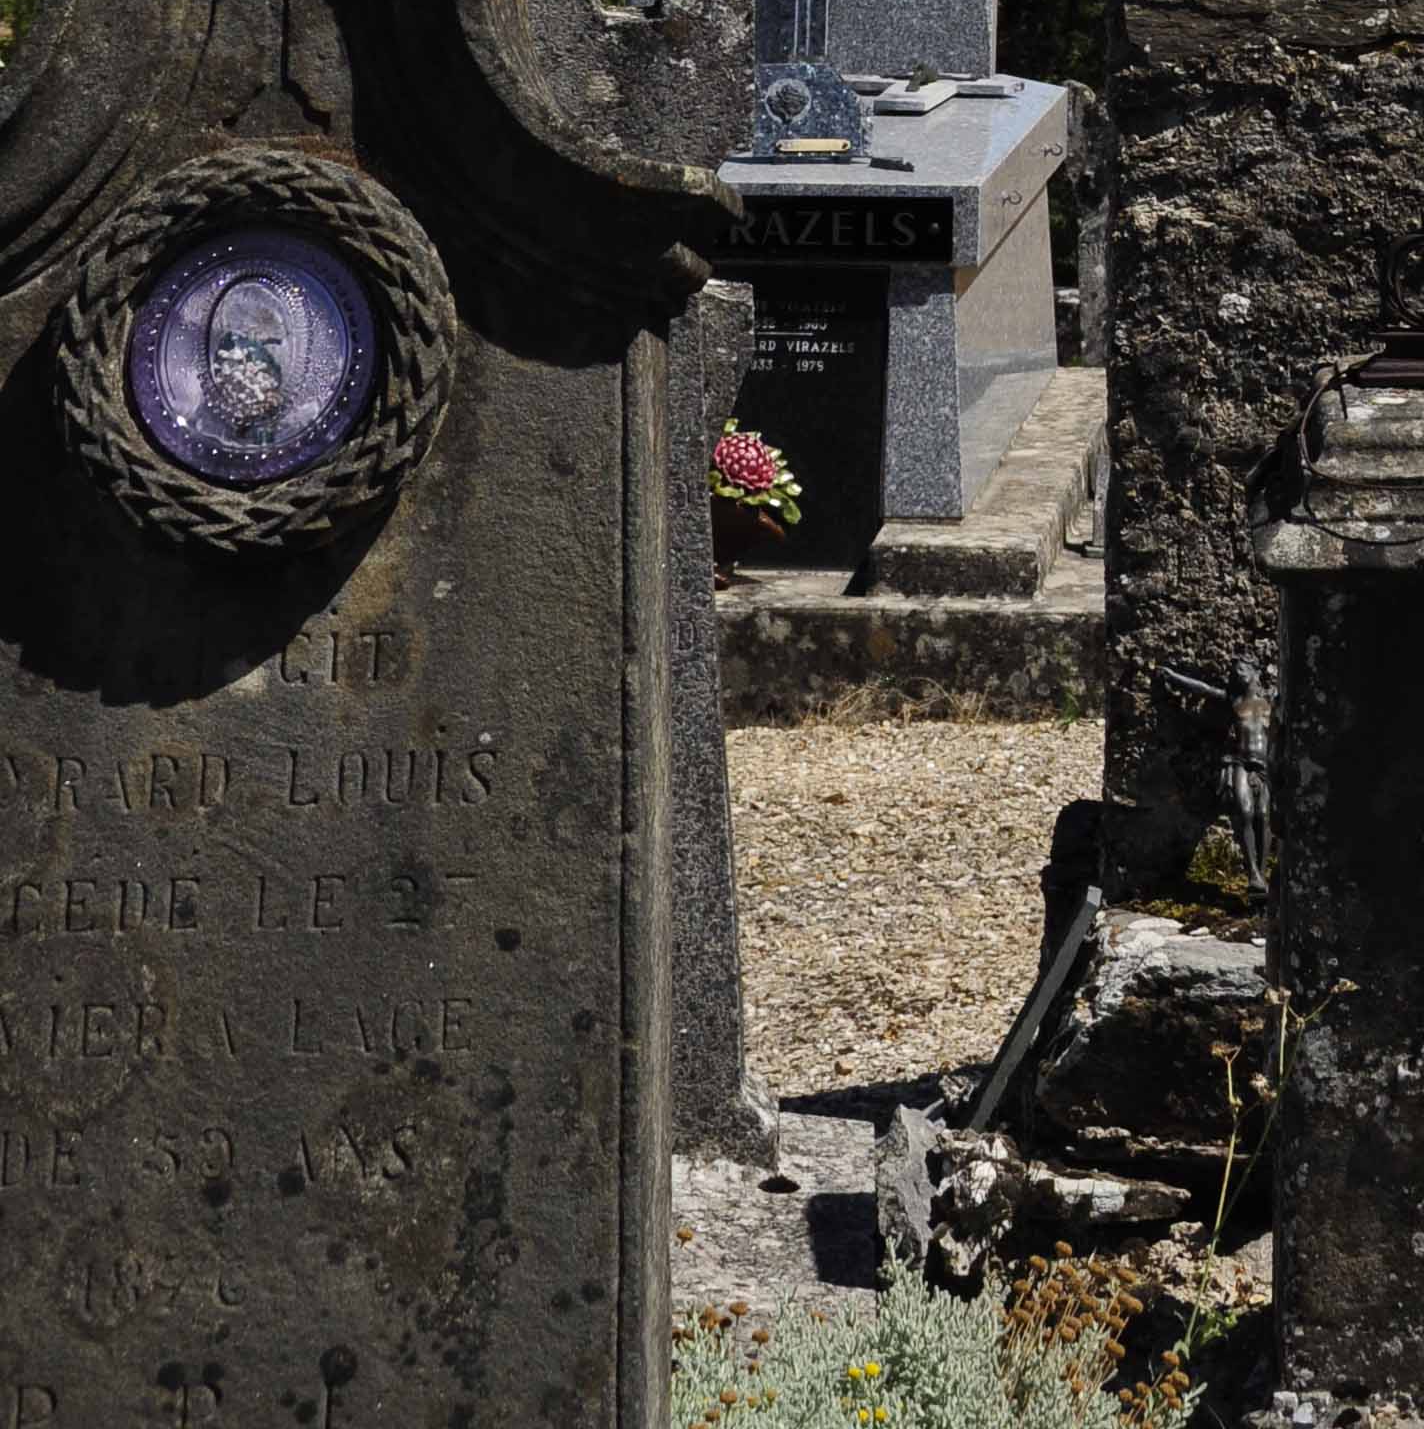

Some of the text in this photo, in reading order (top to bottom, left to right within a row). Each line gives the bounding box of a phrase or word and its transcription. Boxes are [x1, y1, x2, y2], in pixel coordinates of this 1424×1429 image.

[715, 209, 921, 247] RAZELS
[287, 748, 498, 808] LOUIS
[256, 874, 347, 931] LE
[1, 1129, 84, 1187] DE
